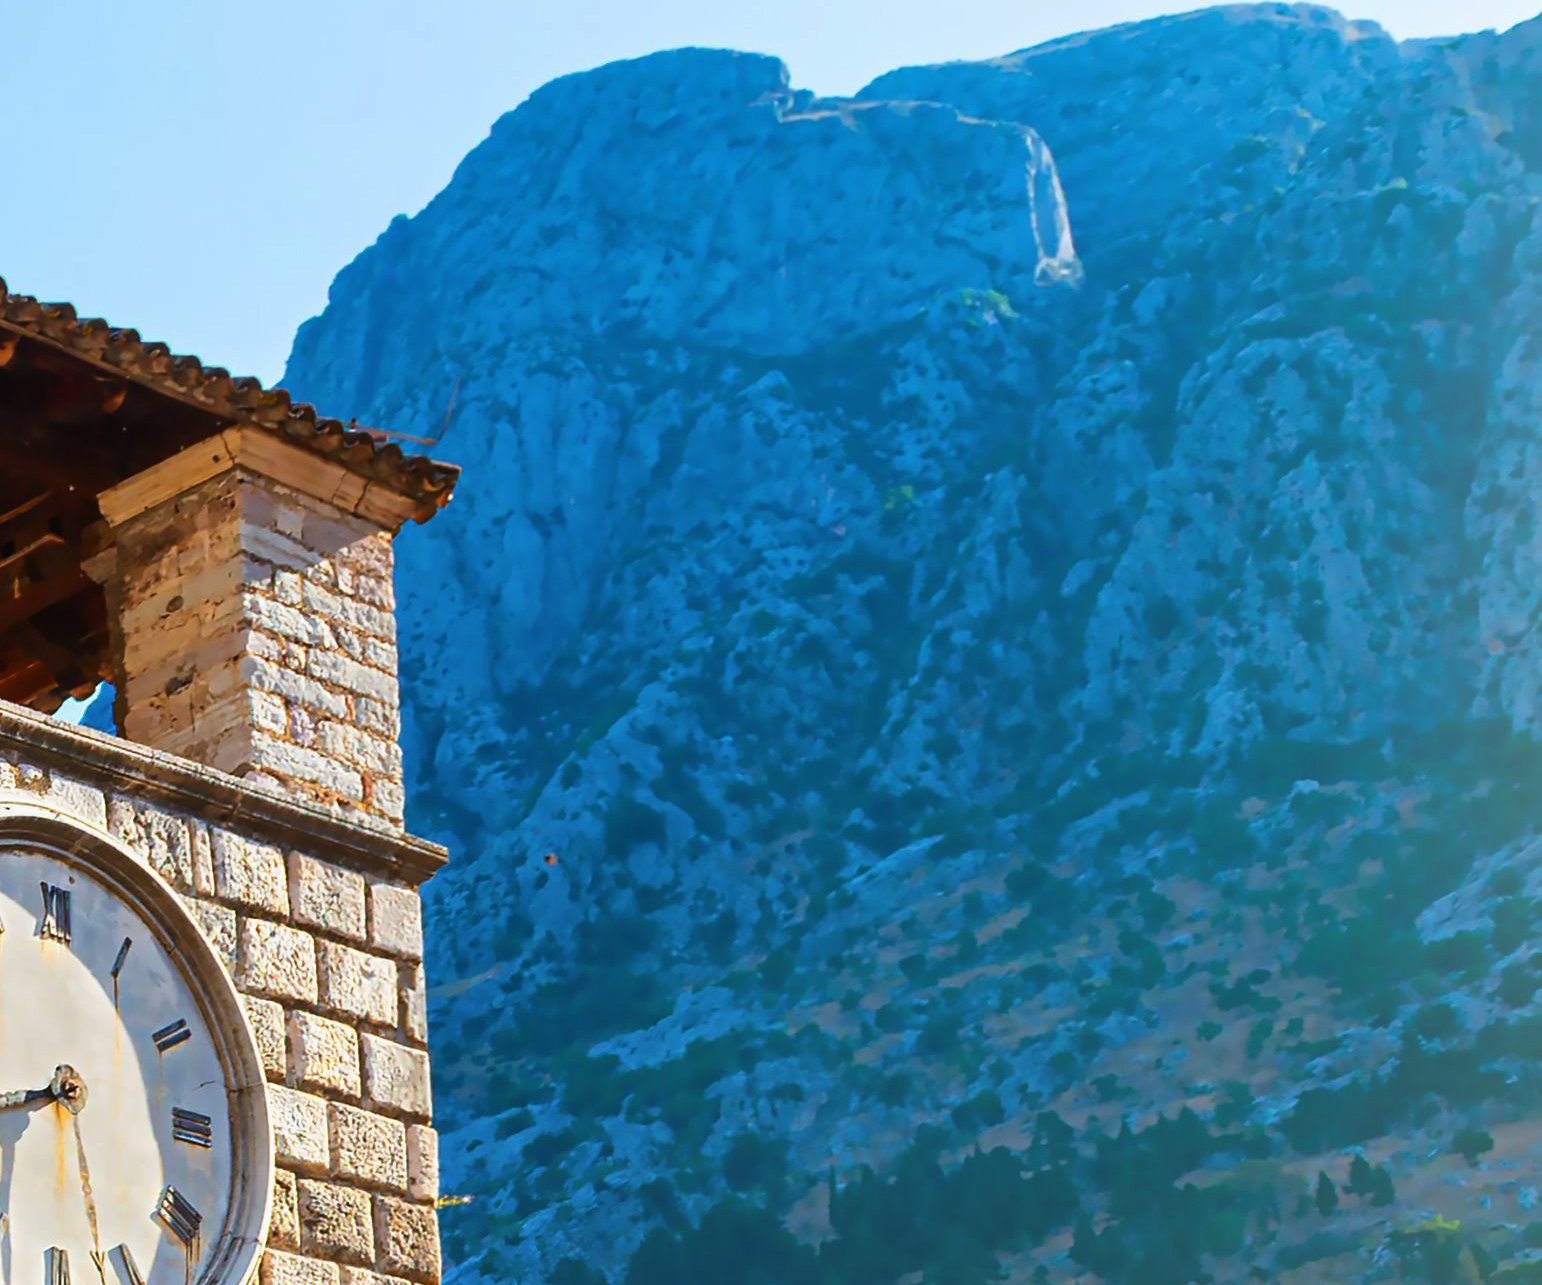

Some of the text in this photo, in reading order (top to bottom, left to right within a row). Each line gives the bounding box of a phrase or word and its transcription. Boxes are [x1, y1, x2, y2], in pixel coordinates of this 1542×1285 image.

[40, 881, 72, 946] XII
[111, 937, 133, 978] I
[152, 1018, 192, 1053] II
[172, 1106, 212, 1148] III
[158, 1184, 204, 1247] IIII
